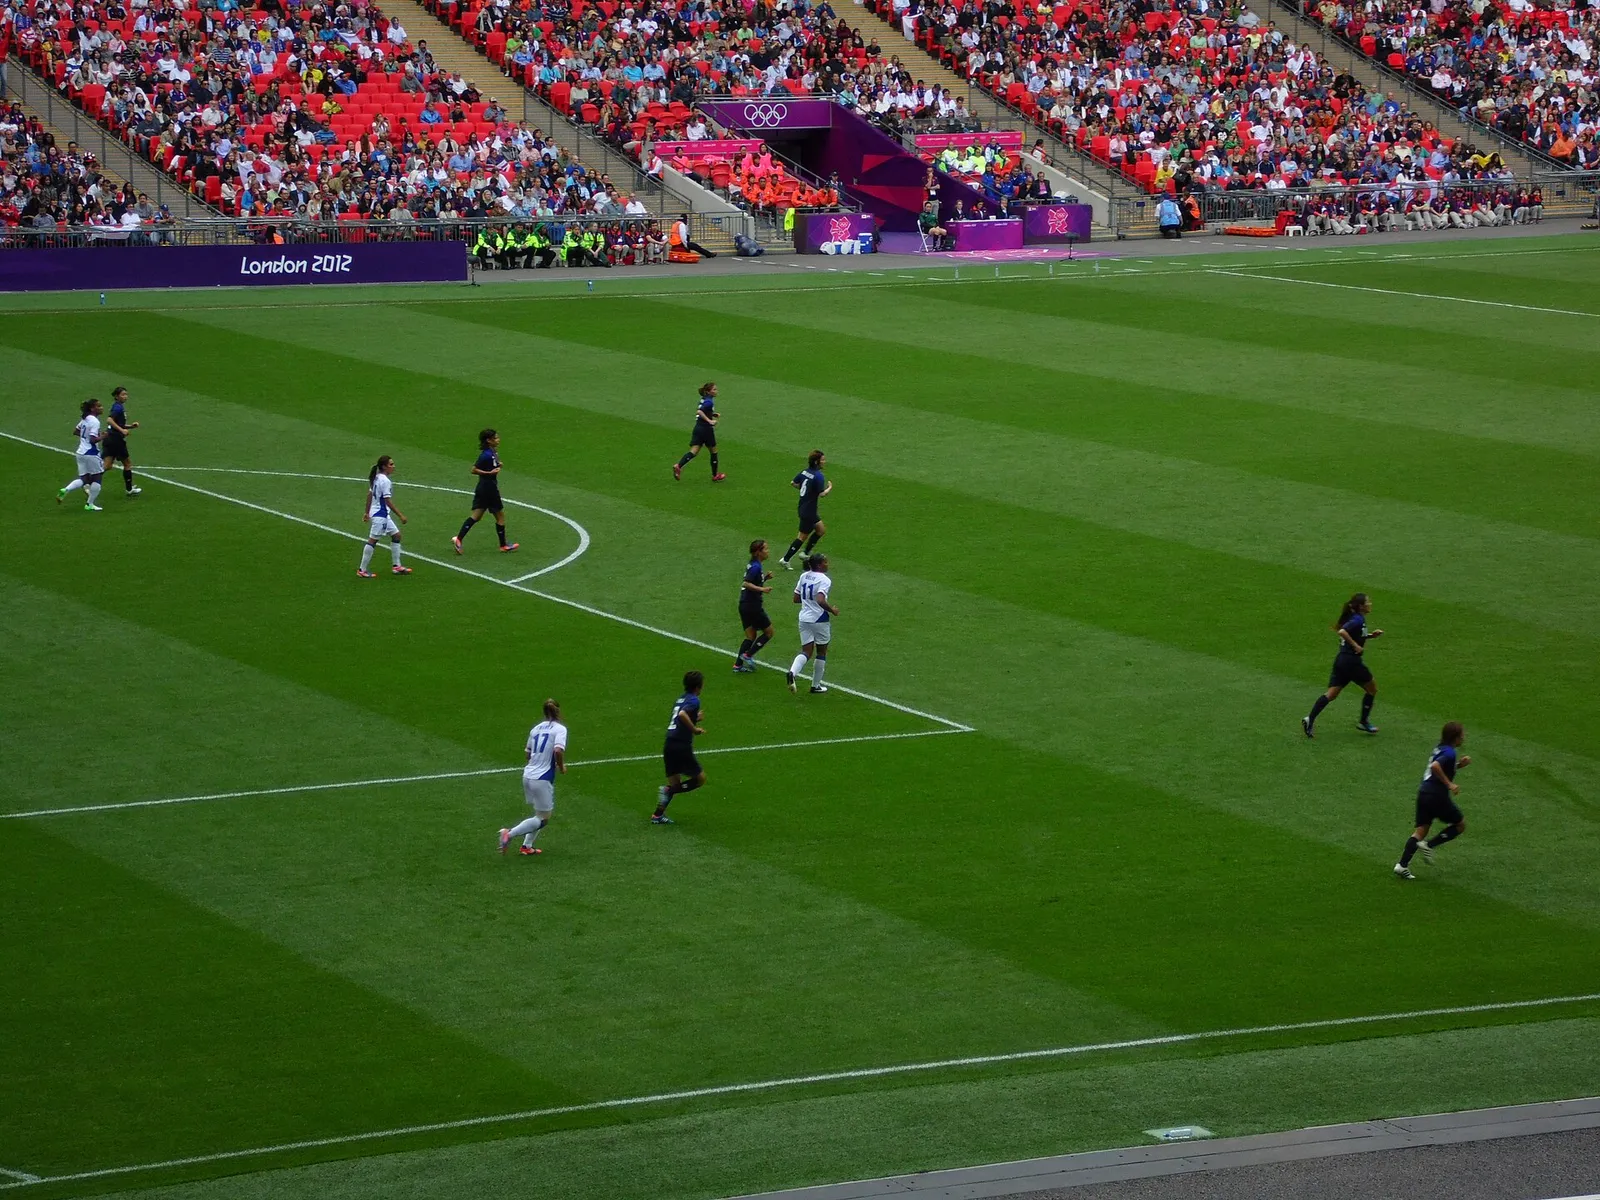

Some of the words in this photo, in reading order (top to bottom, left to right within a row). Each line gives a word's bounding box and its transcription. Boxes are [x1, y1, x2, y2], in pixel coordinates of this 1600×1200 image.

[241, 255, 308, 274] London
[311, 254, 352, 273] 2012
[800, 478, 809, 497] 6
[802, 582, 814, 600] 11
[533, 733, 549, 753] 17
